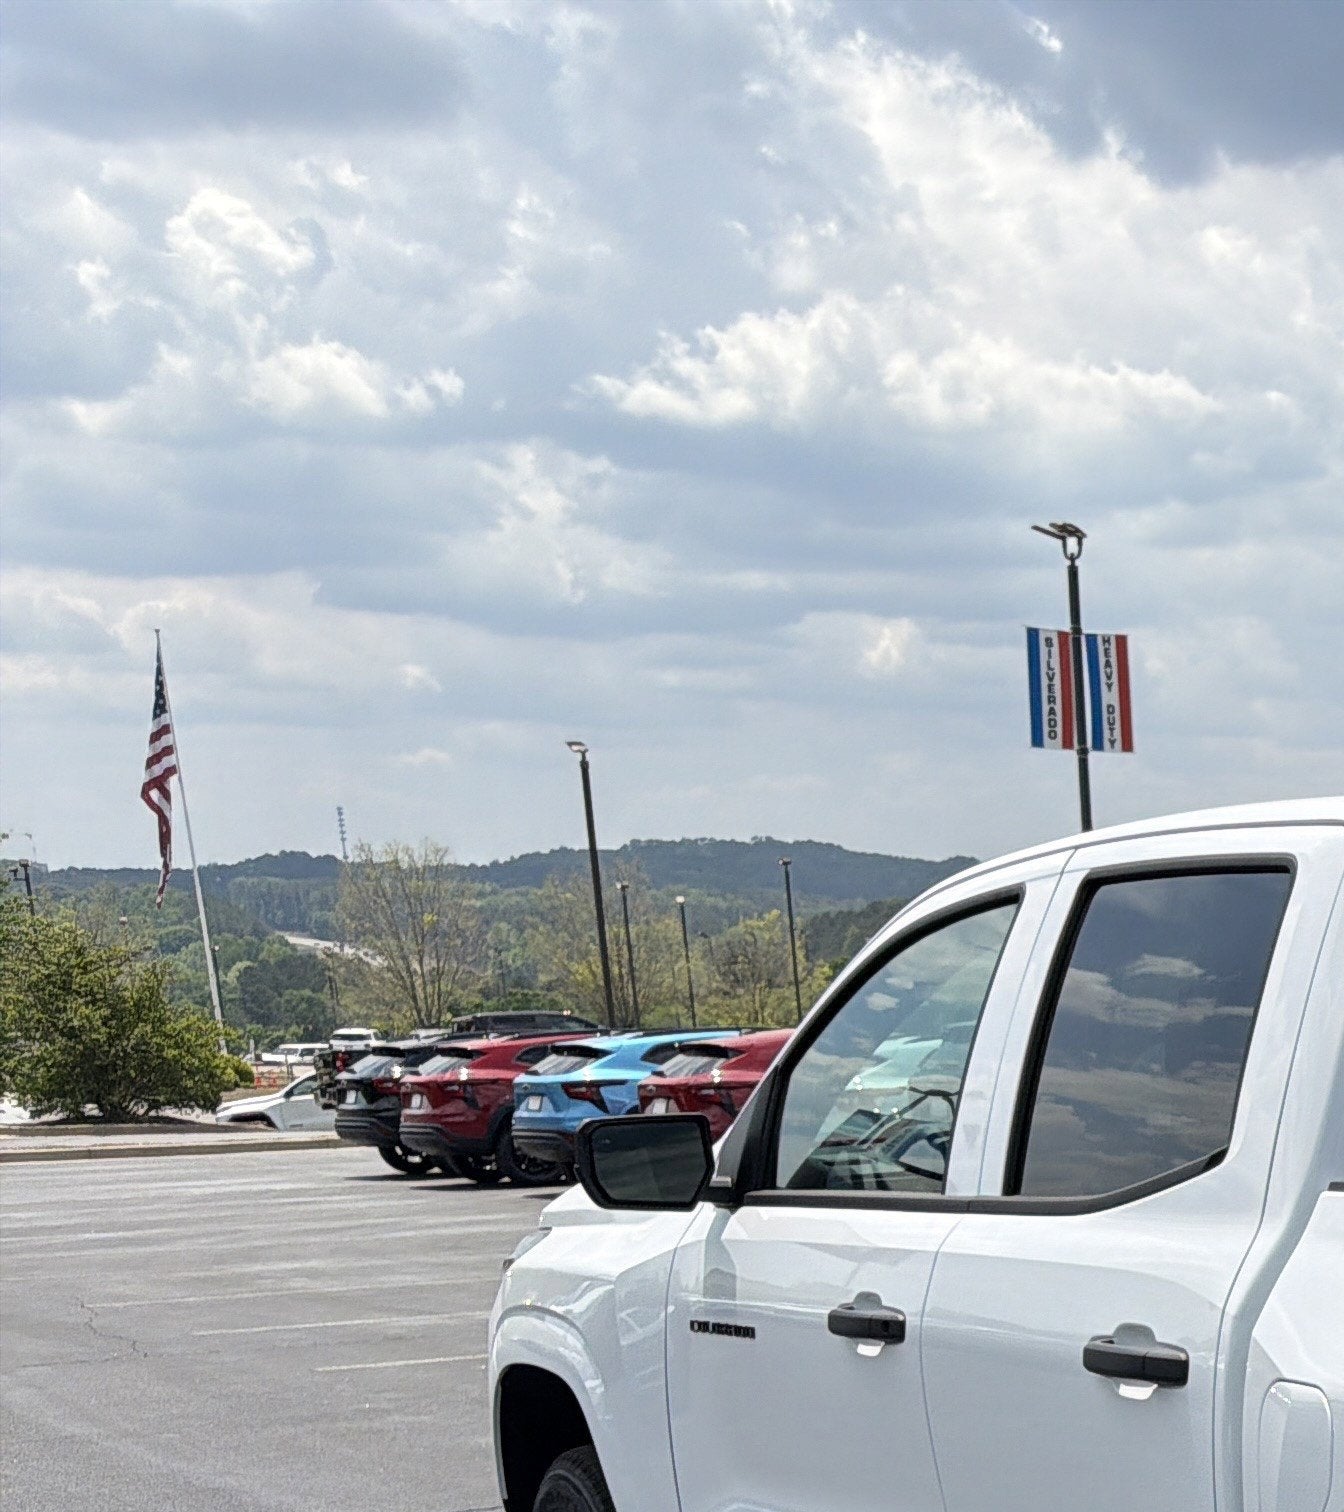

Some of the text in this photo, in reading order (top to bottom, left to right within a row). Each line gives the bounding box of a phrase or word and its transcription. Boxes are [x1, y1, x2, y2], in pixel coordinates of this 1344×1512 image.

[1044, 636, 1057, 740] SILVERADO
[1102, 636, 1117, 750] HEAVY DUTY
